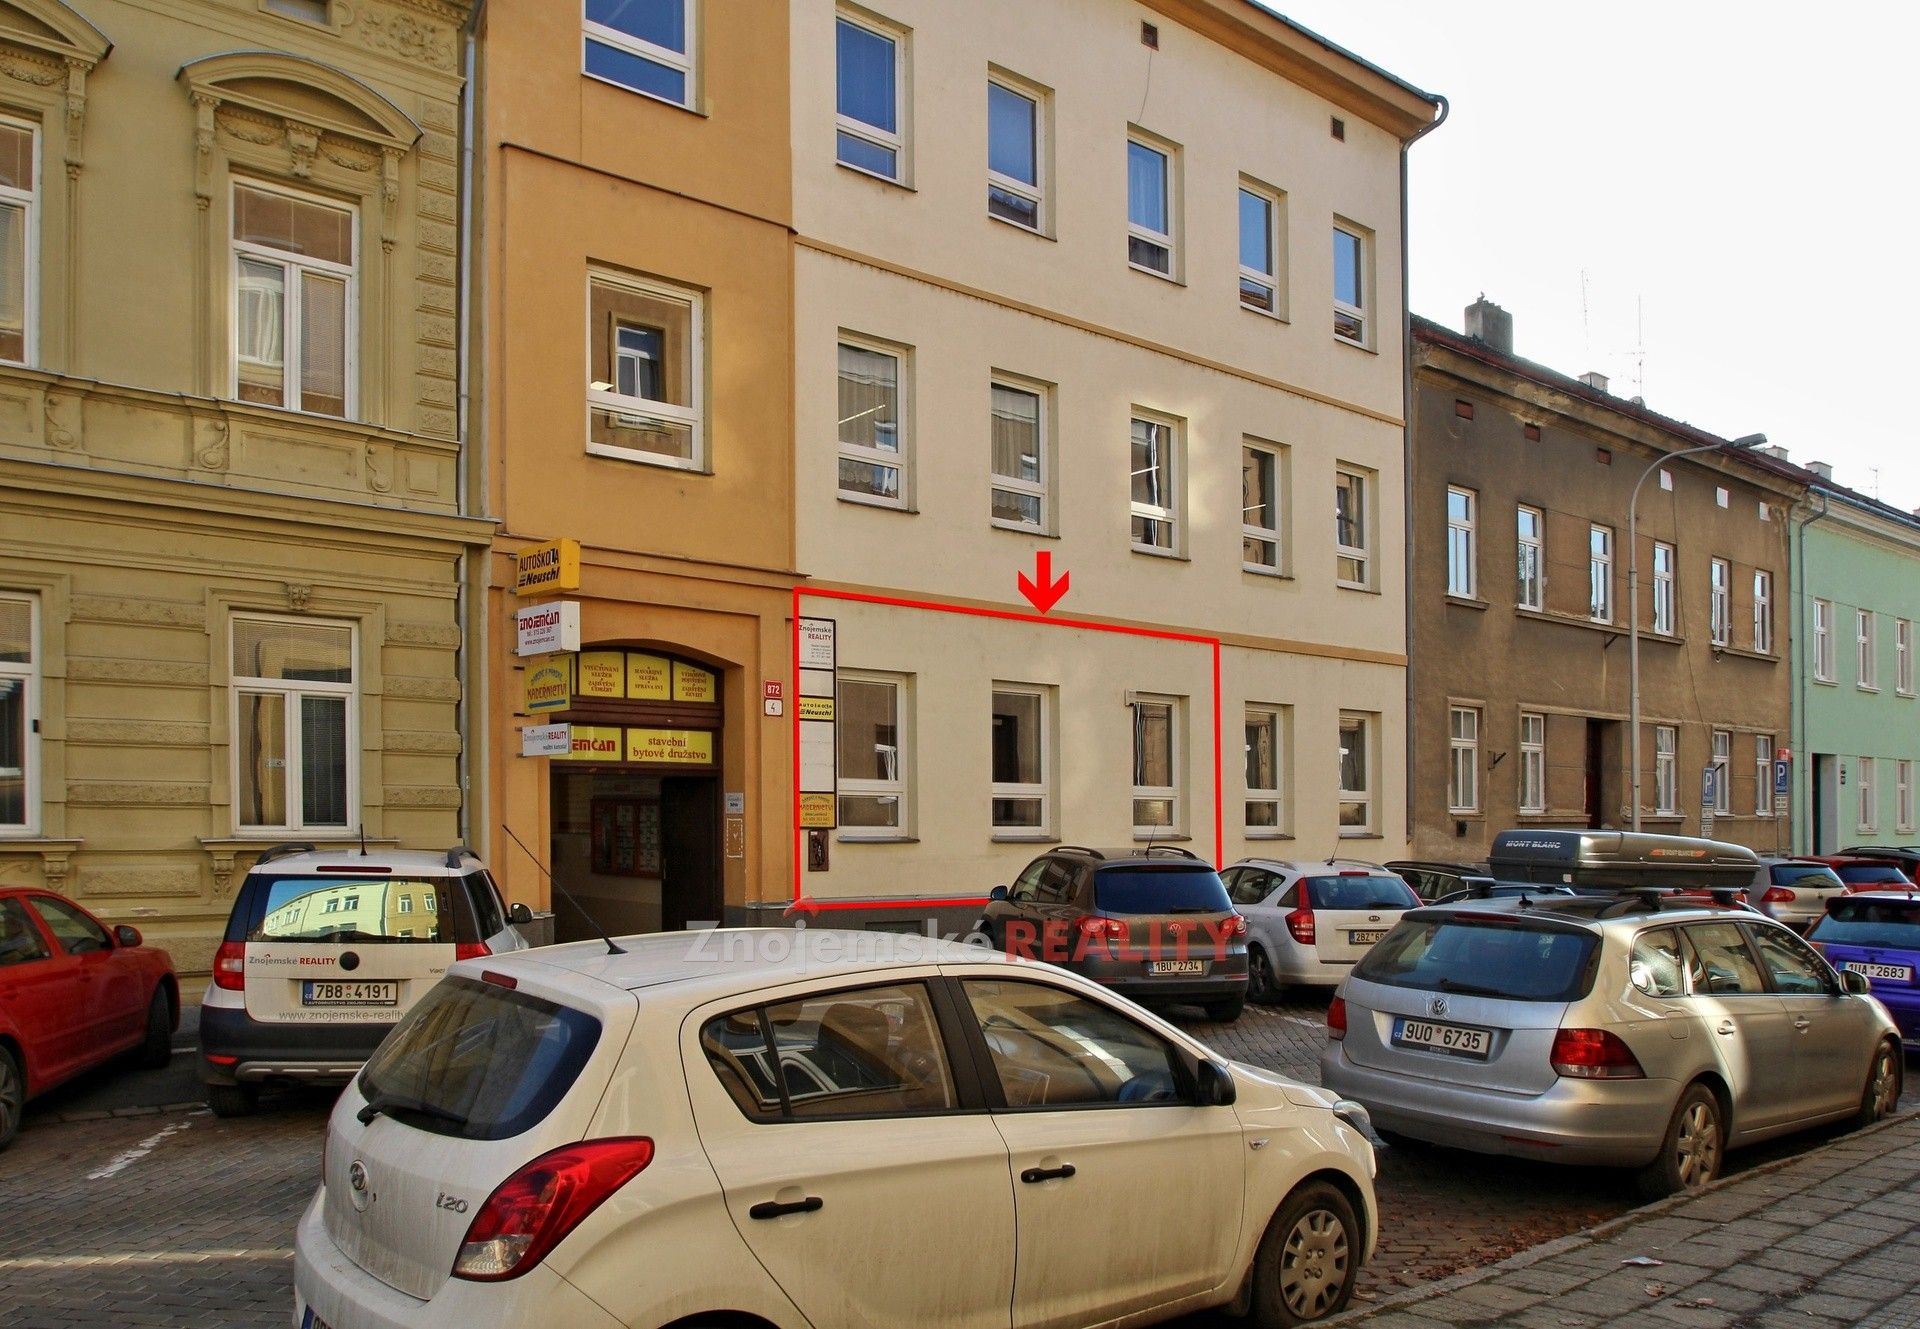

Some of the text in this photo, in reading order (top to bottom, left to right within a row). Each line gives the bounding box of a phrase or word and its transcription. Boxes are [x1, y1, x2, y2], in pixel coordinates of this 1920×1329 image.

[526, 567, 560, 586] Neuschl
[808, 633, 832, 641] REALITY
[767, 684, 780, 694] 872
[770, 702, 776, 713] 4
[548, 731, 567, 740] REALITY
[648, 736, 686, 747] stavební
[572, 738, 616, 752] EMČAN
[633, 747, 707, 760] bytové družstvo
[1777, 764, 1786, 784] P
[1704, 772, 1713, 794] P
[1506, 840, 1562, 849] MONT BLANC
[249, 955, 336, 966] Znojemské REALITY
[1156, 961, 1199, 971] 1BU 2734
[1876, 966, 1905, 979] 2683
[316, 984, 343, 999] 7B8
[354, 984, 389, 999] 4191
[1442, 1028, 1482, 1050] 6735
[435, 1192, 469, 1214] i20
